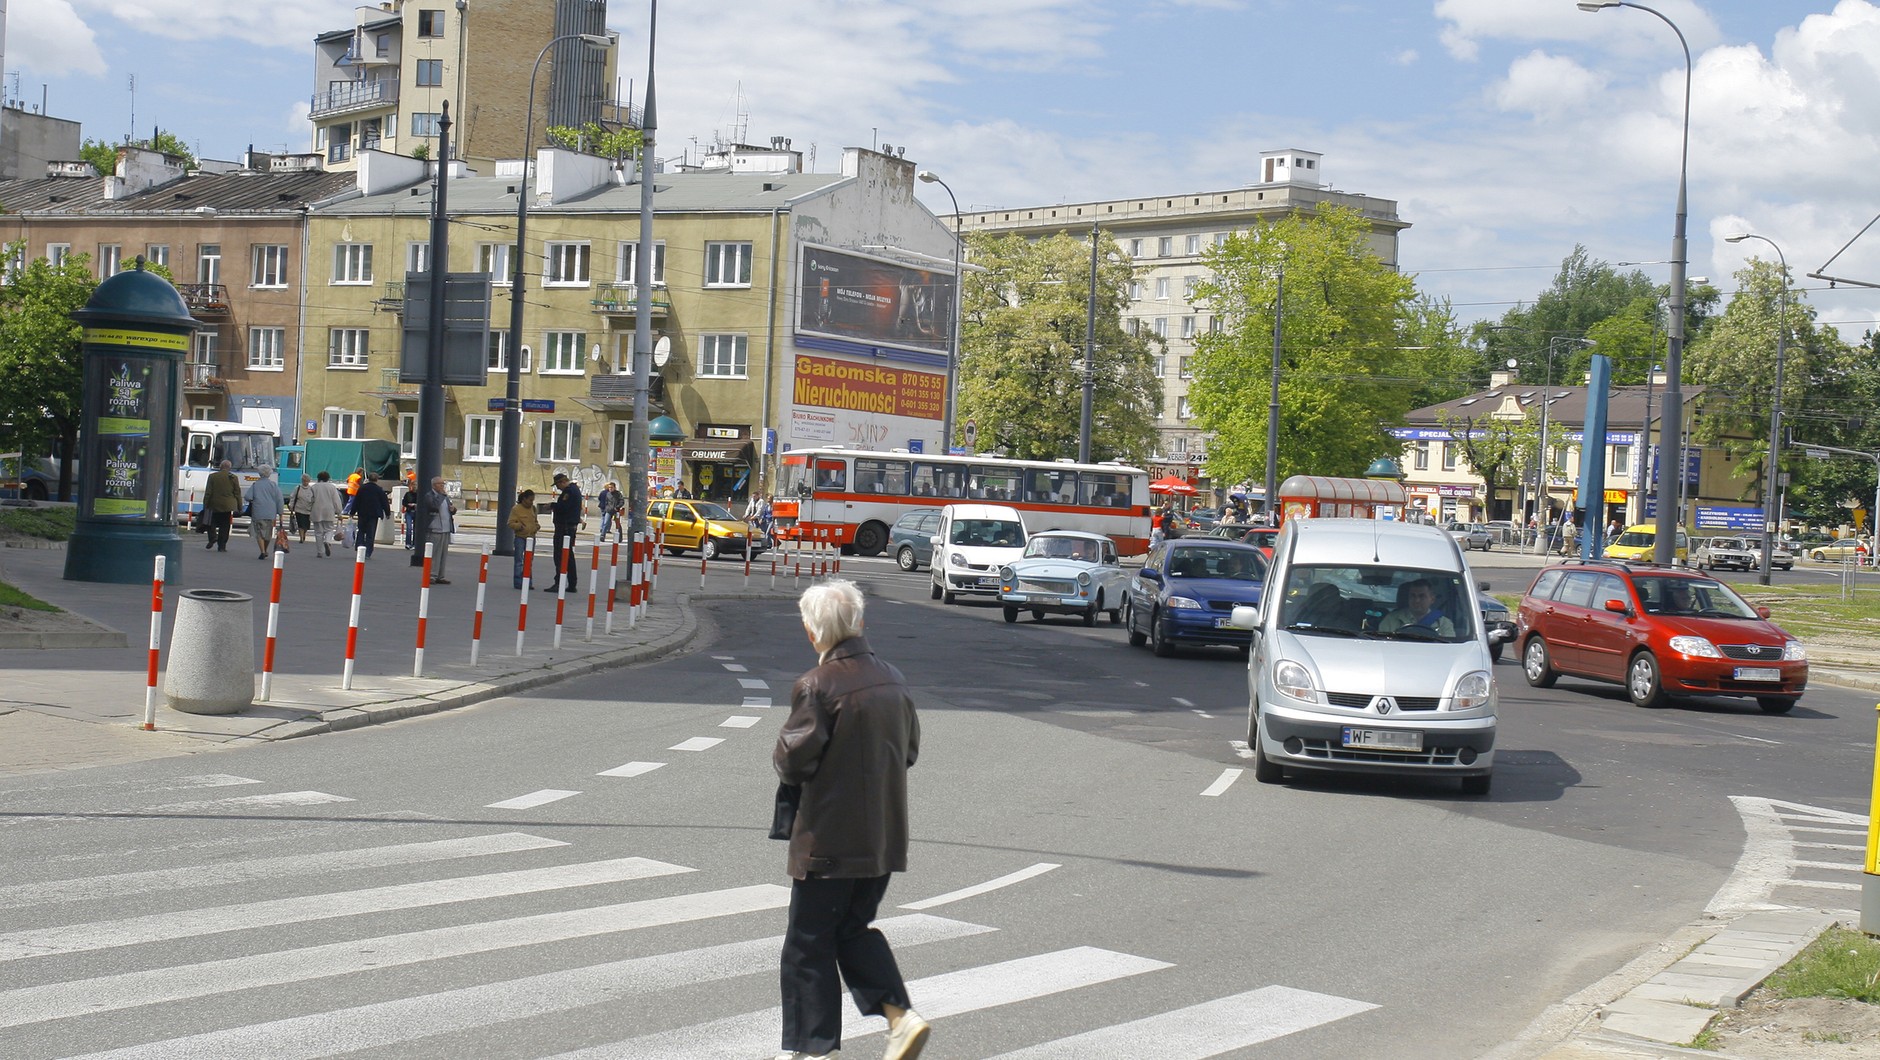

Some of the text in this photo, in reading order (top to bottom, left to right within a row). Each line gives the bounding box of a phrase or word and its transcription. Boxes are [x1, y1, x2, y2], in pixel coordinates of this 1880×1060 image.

[796, 357, 897, 386] Gadomska
[109, 378, 141, 389] Paliwa
[902, 372, 942, 390] 870 55 55
[119, 388, 131, 399] są
[794, 377, 897, 415] Nieruchomości
[901, 387, 941, 401] 0-601 355 130
[109, 396, 139, 407] różne!
[900, 399, 941, 412] 0-601 355 320
[691, 450, 727, 459] OBUWIE
[106, 459, 137, 469] Paliwa
[115, 470, 127, 480] są
[105, 478, 135, 488] różne!
[1220, 618, 1231, 627] WE
[1352, 729, 1373, 744] WF
